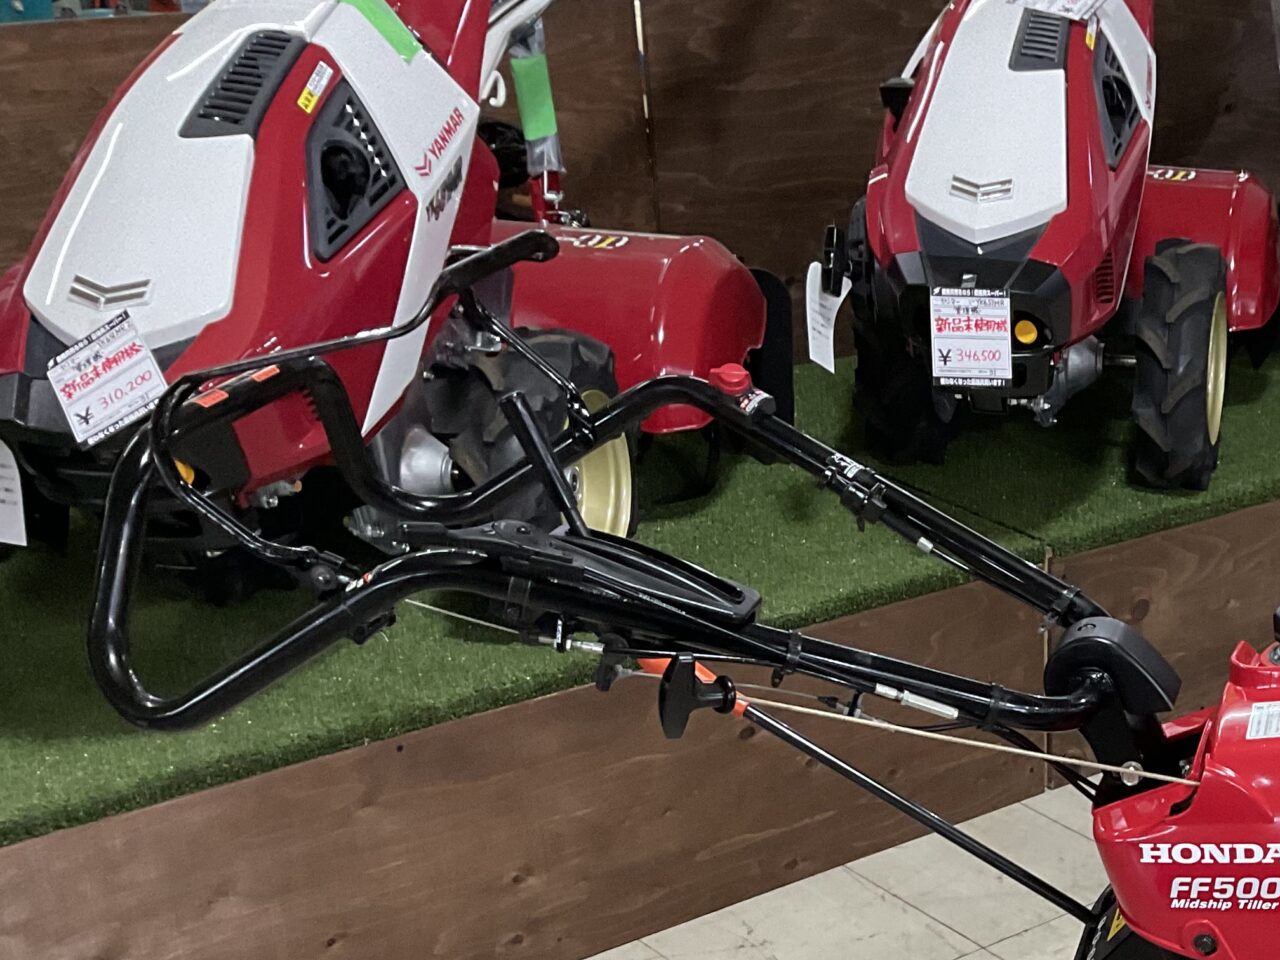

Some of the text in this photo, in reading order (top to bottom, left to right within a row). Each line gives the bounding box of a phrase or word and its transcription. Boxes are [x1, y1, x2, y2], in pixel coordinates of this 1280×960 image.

[428, 107, 465, 160] YANMAR
[1171, 899, 1280, 911] Midship Tiller
